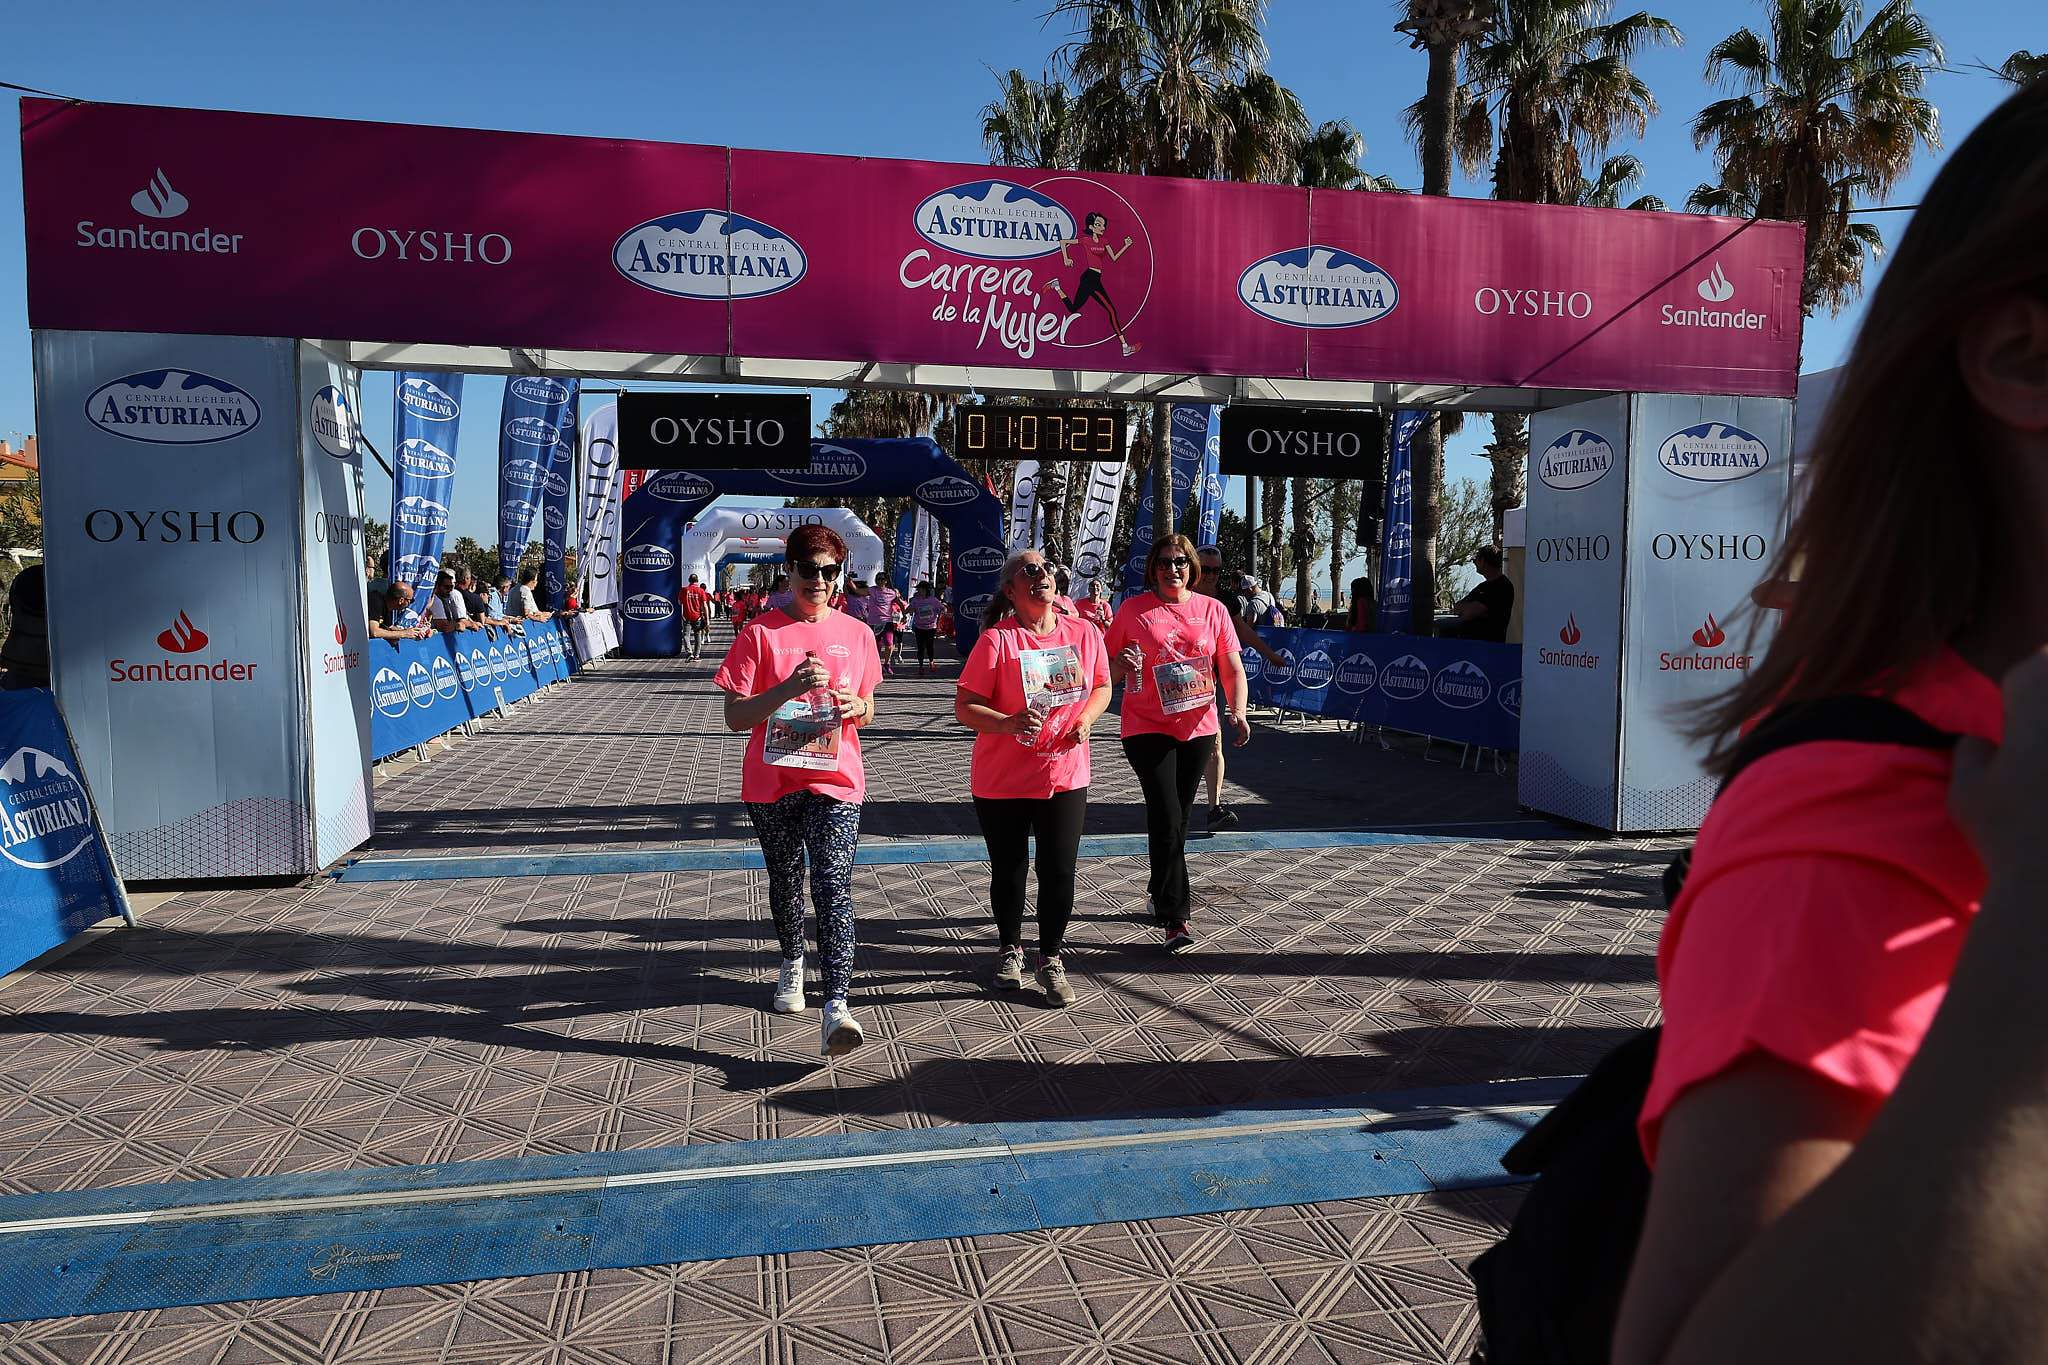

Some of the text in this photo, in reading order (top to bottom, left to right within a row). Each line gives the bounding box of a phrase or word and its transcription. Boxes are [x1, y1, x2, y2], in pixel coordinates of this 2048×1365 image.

[926, 205, 1063, 242] ASTURIANA
[952, 205, 1060, 219] CENTRAL LECHERA
[77, 221, 243, 253] Santander
[351, 227, 512, 265] OYSHO
[659, 238, 786, 252] CENTRAL LECHERA
[628, 239, 792, 278] ASTURIANA
[899, 249, 1033, 296] Carrera
[1276, 272, 1382, 285] CENTRAL LECHERA
[1250, 272, 1387, 309] ASTURIANA
[1474, 288, 1592, 319] OYSHO
[932, 293, 1082, 359] de la Mujer
[1661, 304, 1767, 330] Santander
[100, 394, 248, 426] ASTURIANA
[126, 393, 241, 405] CENTRAL LECHERA
[650, 417, 785, 446] OYSHO
[968, 414, 1113, 451] 01:07:23
[1247, 428, 1361, 457] OYSHO
[1543, 455, 1608, 478] ASTURIANA
[1666, 443, 1760, 468] ASTURIANA
[651, 481, 709, 495] ASTURIANA
[921, 487, 976, 499] ASTURIANA
[84, 509, 265, 543] OYSHO
[315, 511, 359, 546] OYSHO
[742, 513, 823, 531] OYSHO
[627, 554, 671, 565] ASTURIANA
[1536, 534, 1610, 563] OYSHO
[1652, 533, 1766, 561] OYSHO
[625, 603, 670, 614] ASTURIANA
[323, 649, 360, 674] Santander
[1539, 647, 1600, 669] Santander
[1660, 652, 1753, 671] Santander
[110, 660, 257, 682] Santander
[1383, 669, 1425, 690] ASTURIANA
[1436, 675, 1483, 700] ASTURIANA
[9, 789, 43, 806] CENTRAL
[0, 798, 88, 848] ASTURIAN
